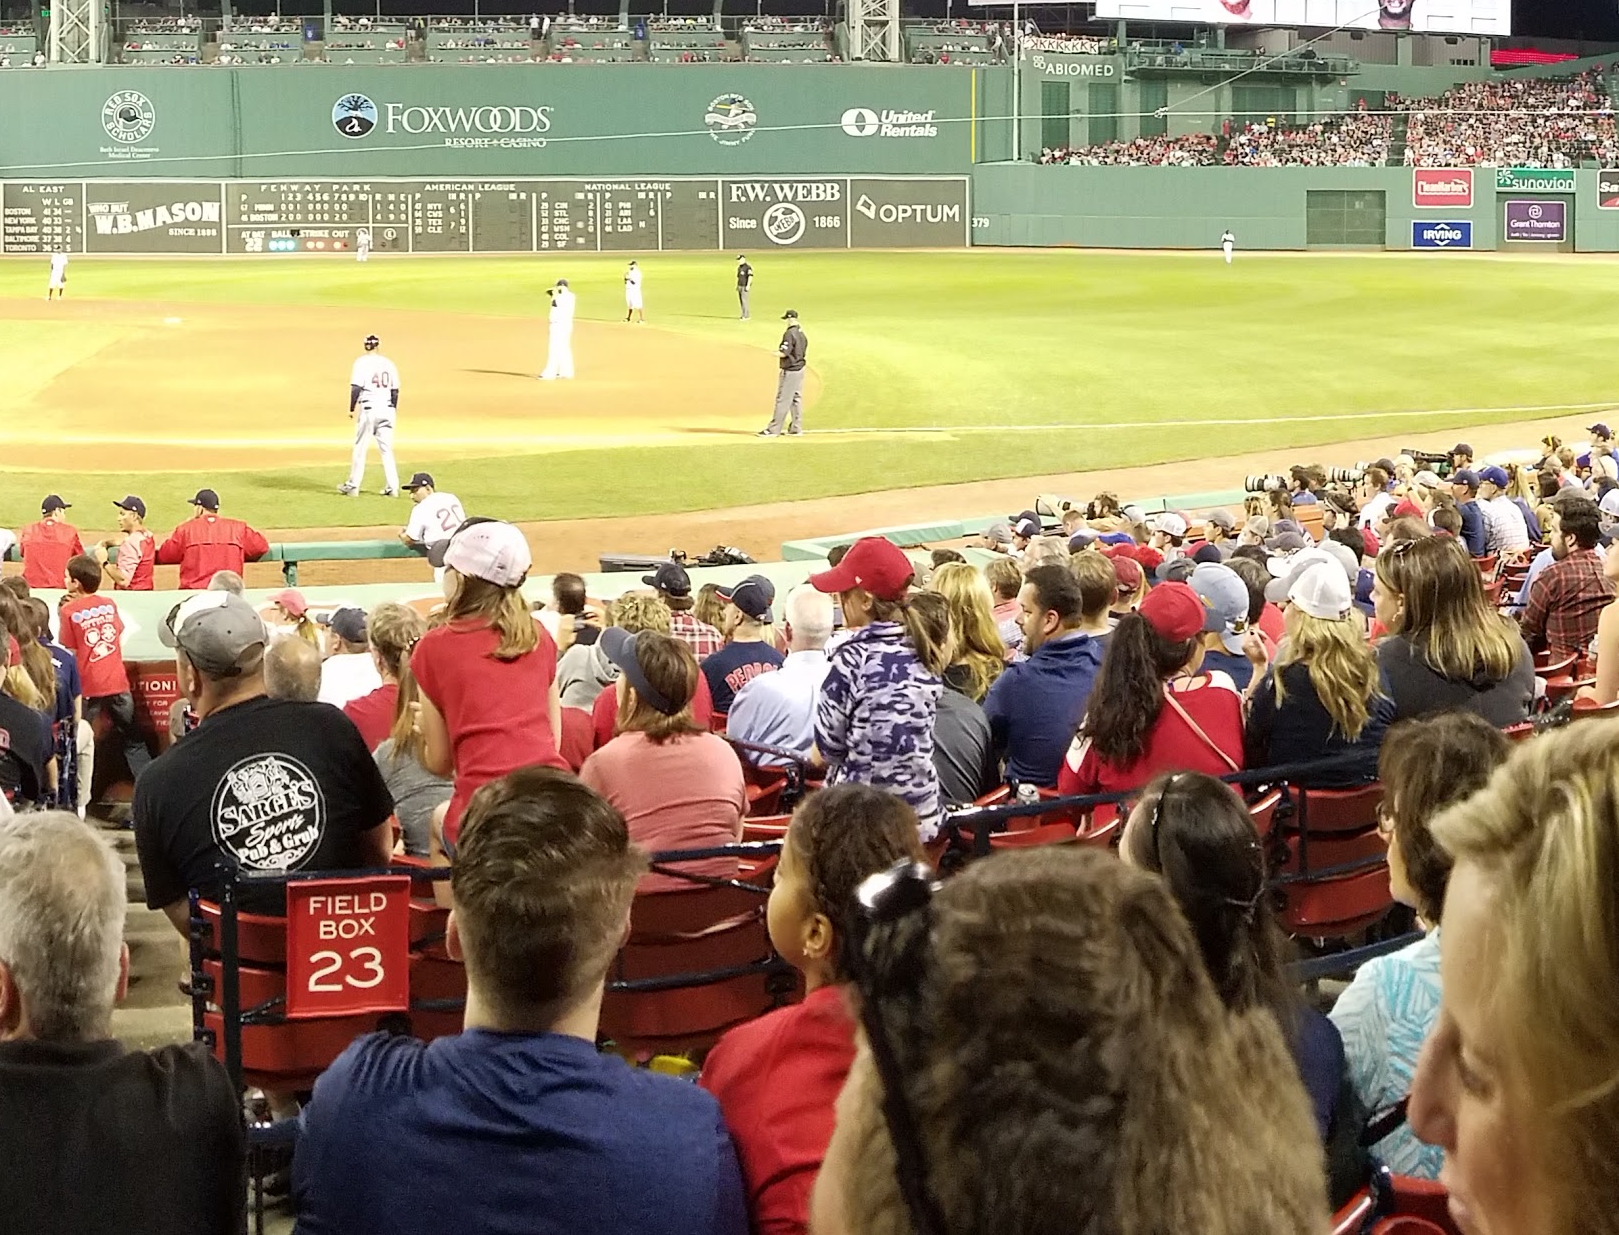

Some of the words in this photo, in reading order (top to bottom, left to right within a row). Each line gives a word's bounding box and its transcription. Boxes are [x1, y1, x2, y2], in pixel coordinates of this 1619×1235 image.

[1046, 64, 1114, 76] ABIOMED
[104, 94, 122, 116] RED
[123, 92, 146, 107] SOX
[384, 103, 551, 134] FOXWOODS
[880, 109, 933, 123] United
[105, 111, 153, 142] SCHOLARS
[880, 124, 938, 137] Rentals
[260, 184, 321, 192] FENWAY
[1512, 176, 1574, 189] sunovion
[776, 182, 841, 201] WEBB
[879, 204, 960, 222] OPTUM
[729, 216, 757, 229] Since
[813, 216, 841, 228] 1866
[971, 217, 990, 228] 379
[168, 228, 196, 236] SINCE
[332, 230, 350, 238] OUT
[1423, 229, 1462, 240] IRVING
[4, 244, 37, 252] TORONTO
[245, 813, 305, 847] Sports
[238, 843, 269, 863] Pub
[269, 839, 283, 854] &
[282, 825, 319, 849] Grub
[309, 891, 388, 916] FIELD
[319, 916, 376, 940] BOX
[308, 947, 387, 993] 23
